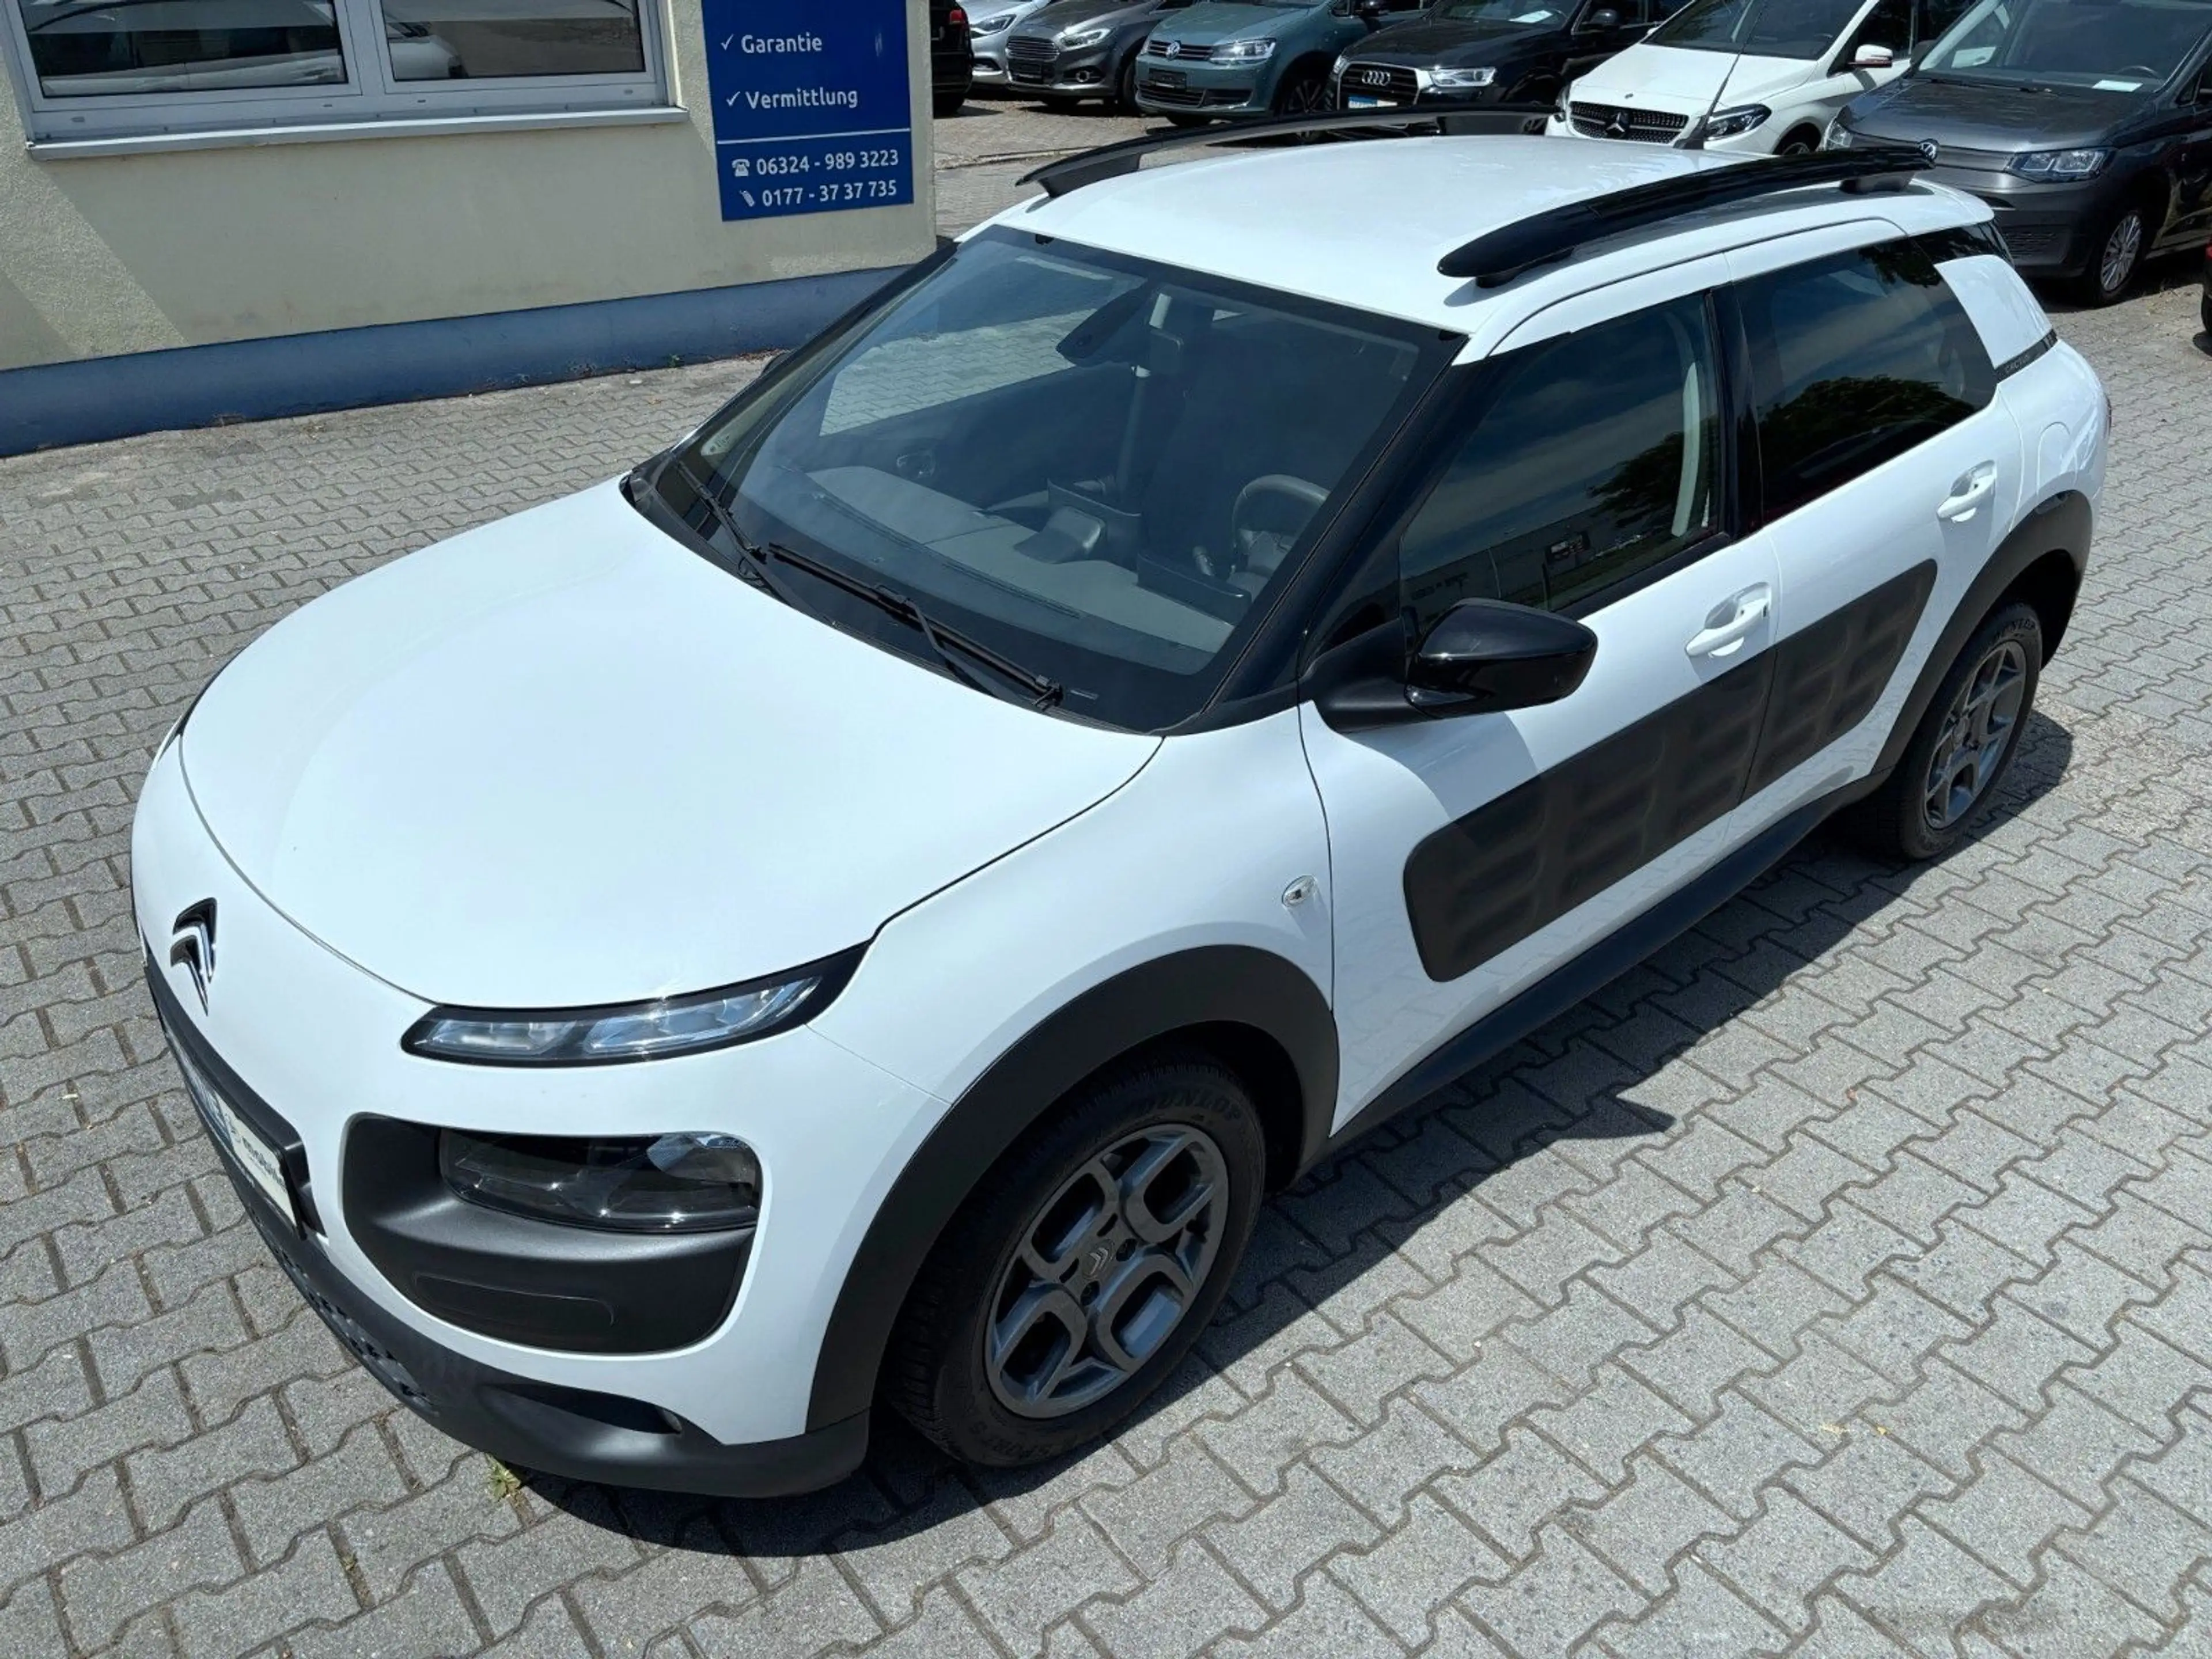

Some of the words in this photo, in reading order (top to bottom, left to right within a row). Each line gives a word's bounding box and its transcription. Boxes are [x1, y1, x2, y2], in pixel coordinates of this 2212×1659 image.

[741, 32, 822, 54] Garantie
[745, 87, 858, 109] Vermittlung
[756, 156, 810, 175] 06324
[825, 152, 855, 171] 989
[860, 149, 899, 168] 3223
[762, 187, 803, 207] 0177
[820, 184, 839, 202] 37
[844, 183, 863, 200] 37
[868, 179, 897, 197] 735
